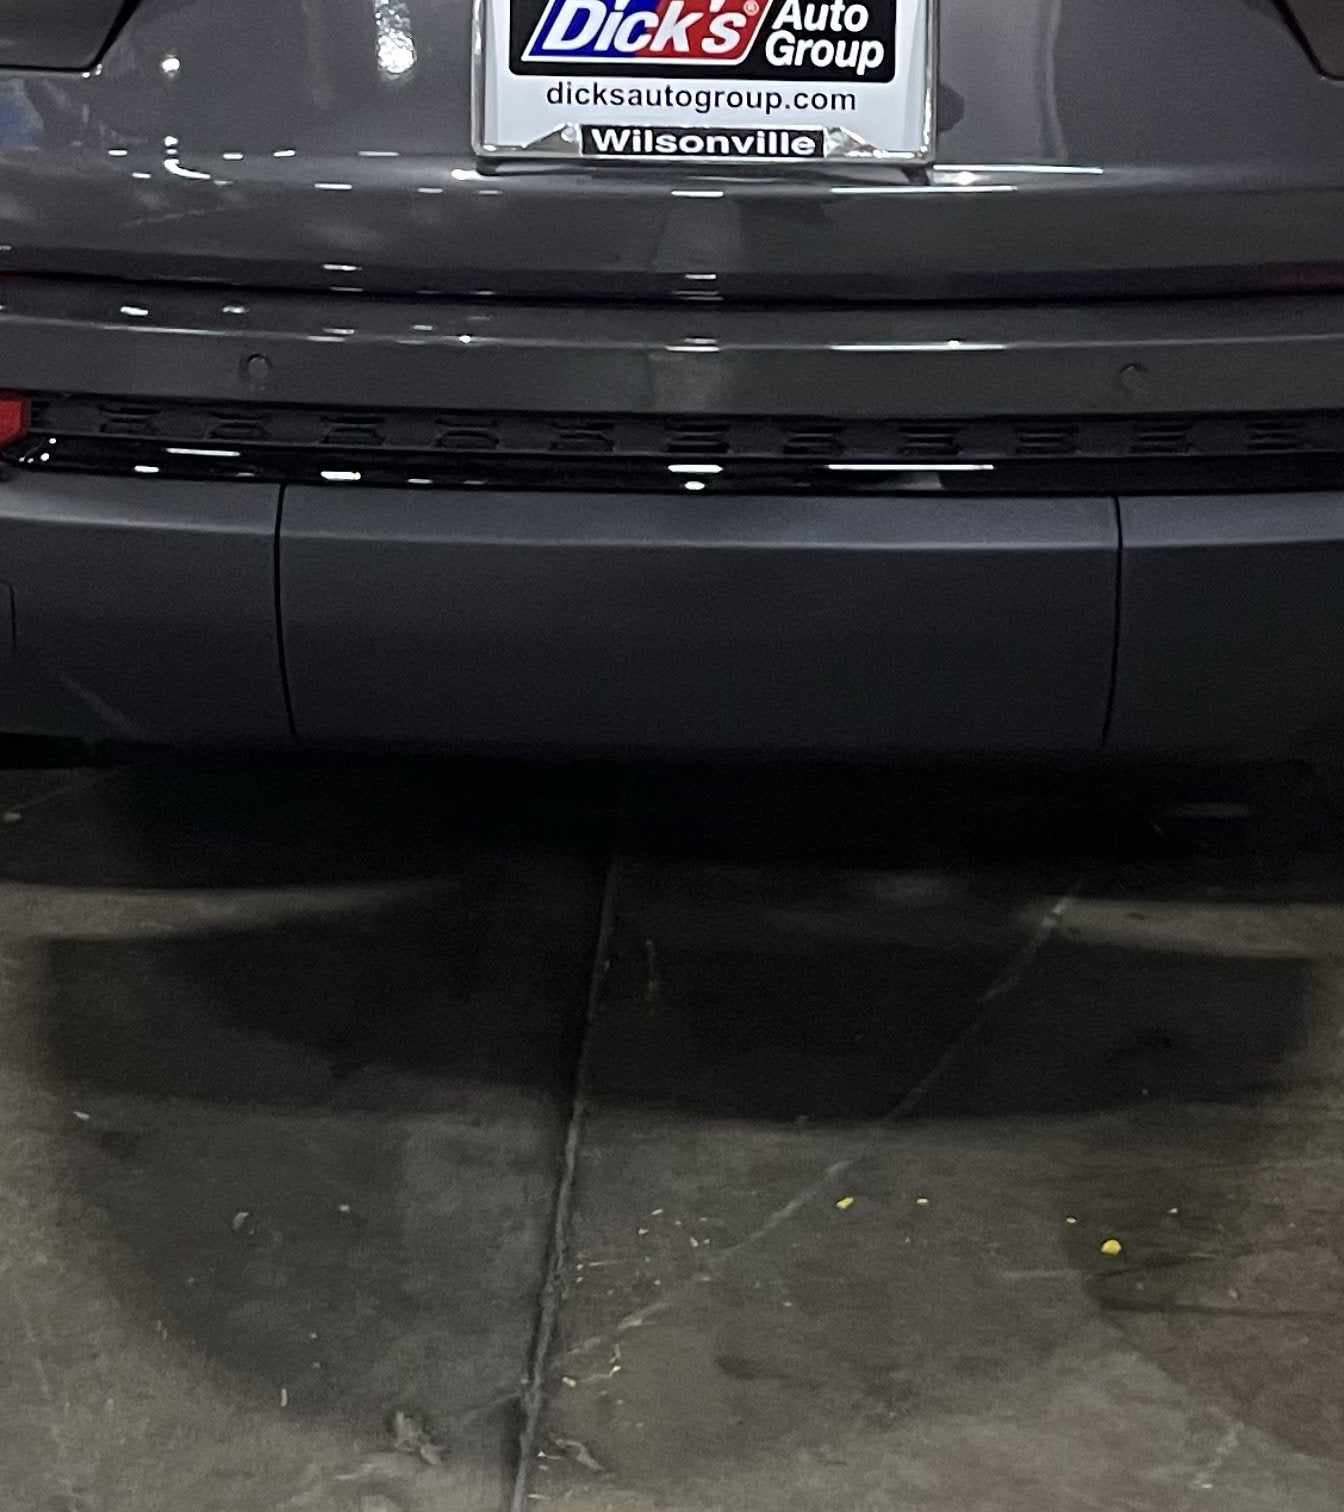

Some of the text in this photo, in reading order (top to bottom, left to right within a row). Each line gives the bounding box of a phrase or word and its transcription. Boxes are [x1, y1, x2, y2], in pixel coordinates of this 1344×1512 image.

[764, 33, 886, 76] Group
[546, 82, 856, 114] dicksautogroup.com
[590, 126, 817, 157] Wilsonville
